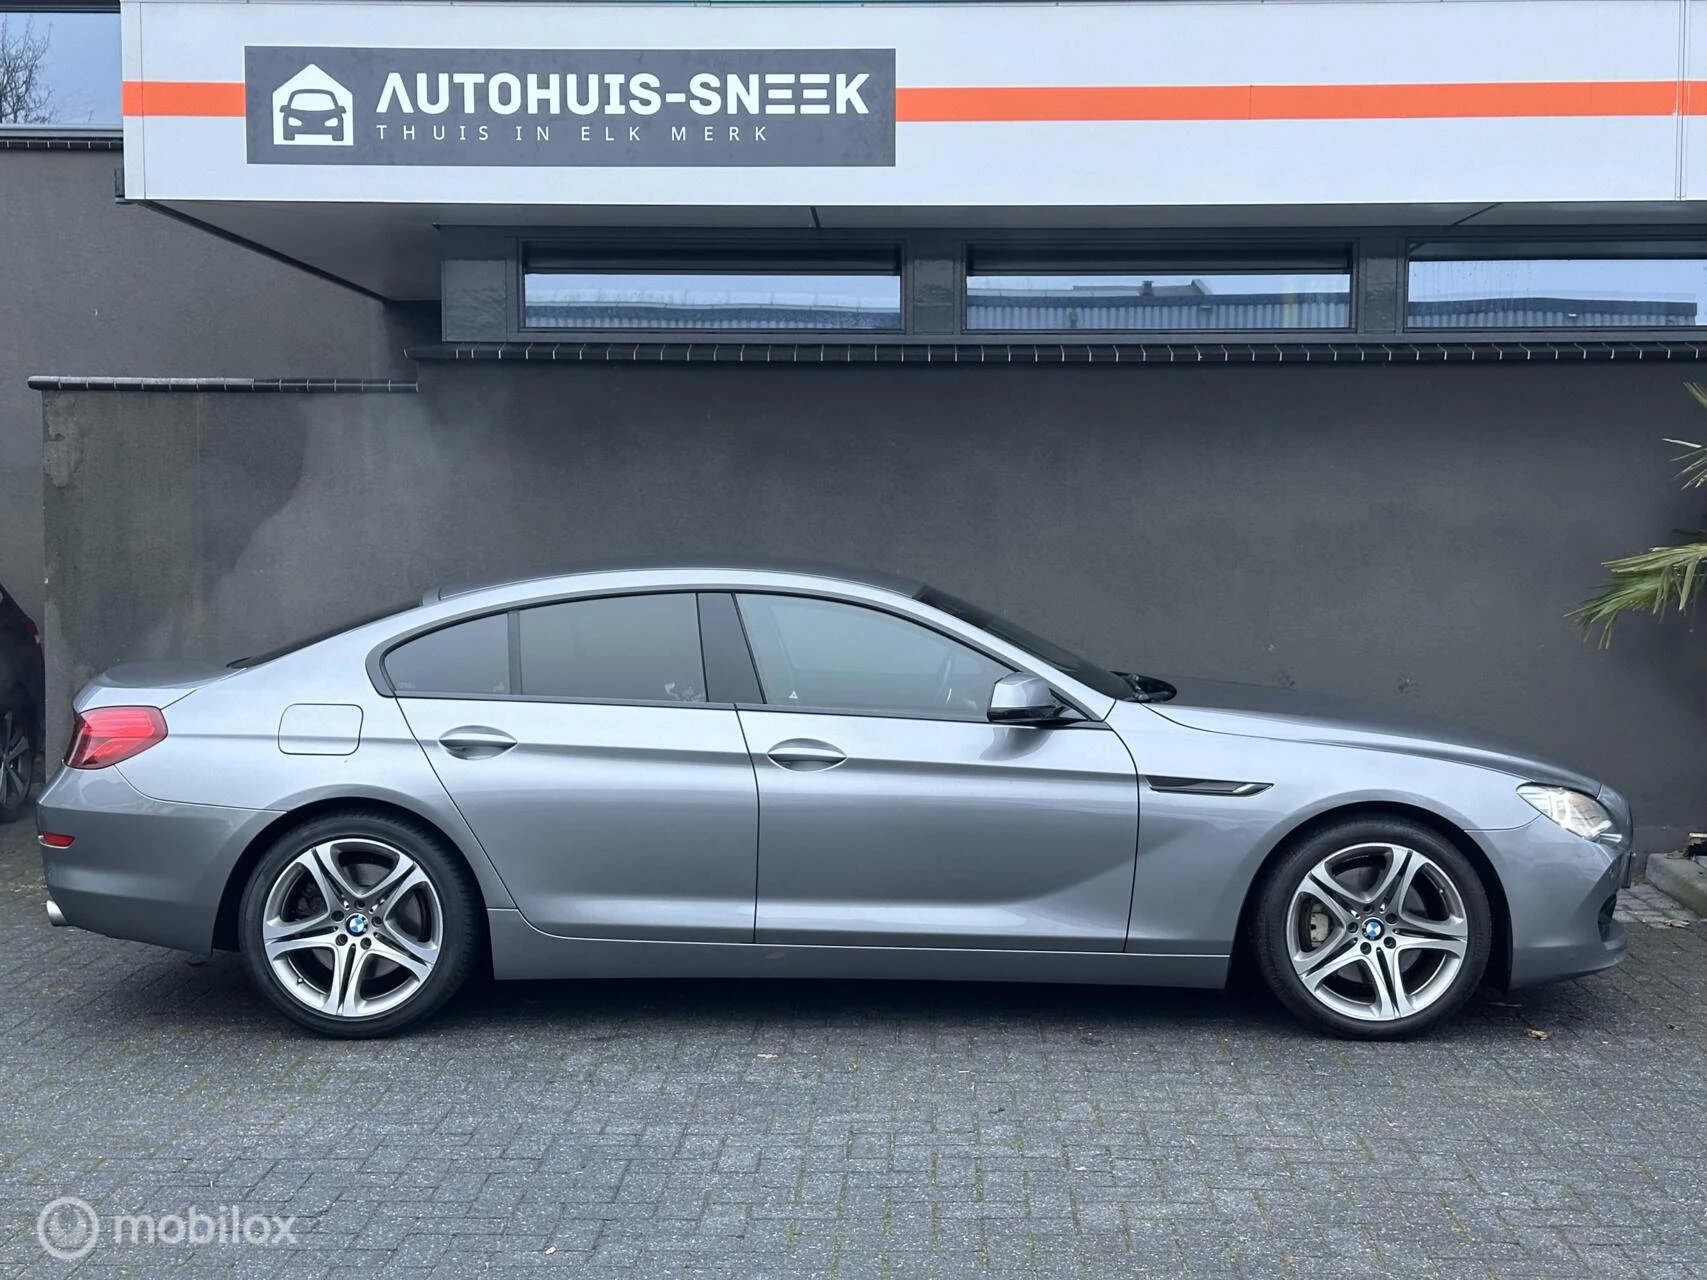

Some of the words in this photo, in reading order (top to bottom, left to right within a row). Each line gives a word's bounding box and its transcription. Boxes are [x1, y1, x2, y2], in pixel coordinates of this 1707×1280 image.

[375, 72, 870, 115] AUTOHUIS-SNEEK
[376, 124, 489, 141] THUIS
[515, 124, 549, 142] IN
[581, 125, 641, 142] ELK
[671, 125, 768, 143] MERK
